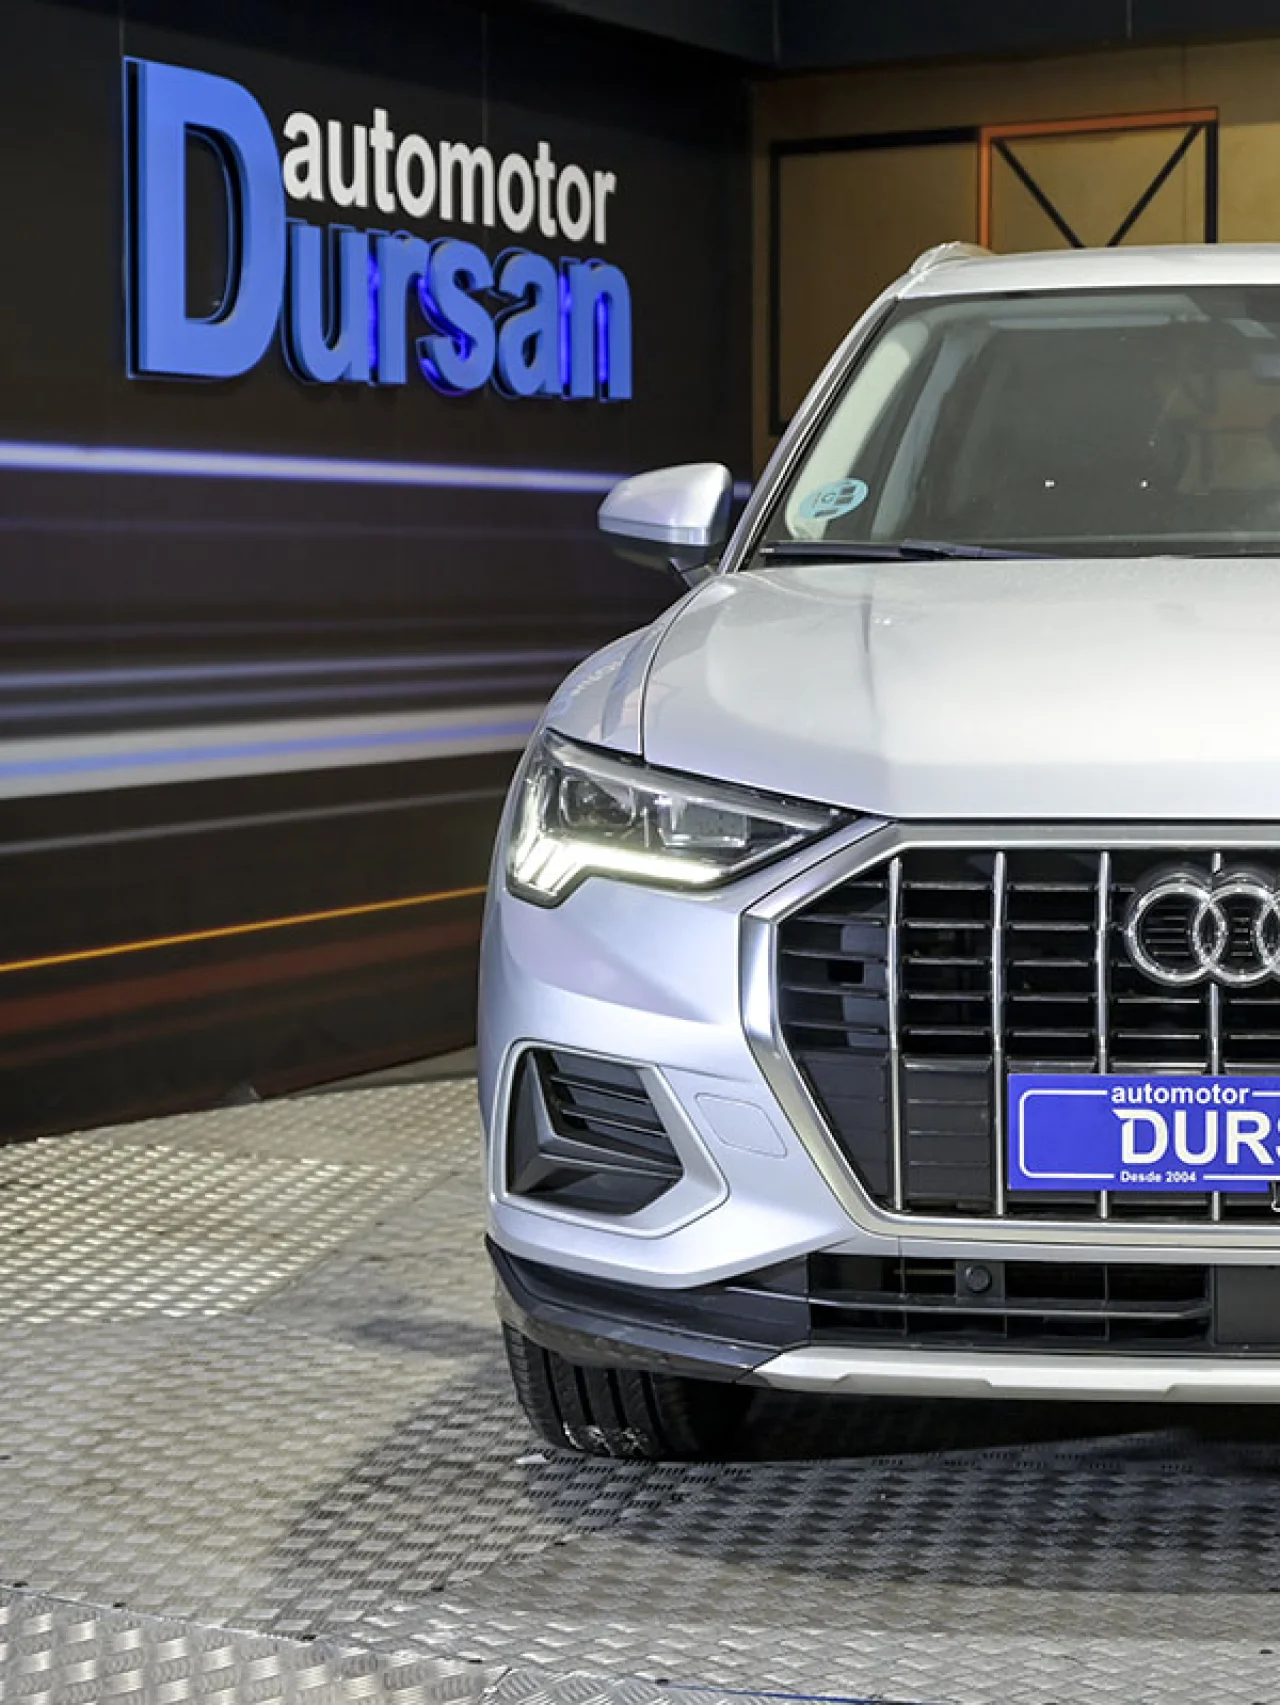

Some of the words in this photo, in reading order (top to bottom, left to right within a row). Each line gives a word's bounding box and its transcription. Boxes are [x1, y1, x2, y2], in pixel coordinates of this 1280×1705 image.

[282, 107, 616, 244] automotor
[123, 55, 633, 403] Dursan
[1111, 1082, 1250, 1104] automotor
[1120, 1170, 1162, 1183] Desde
[1165, 1170, 1197, 1183] 2004
